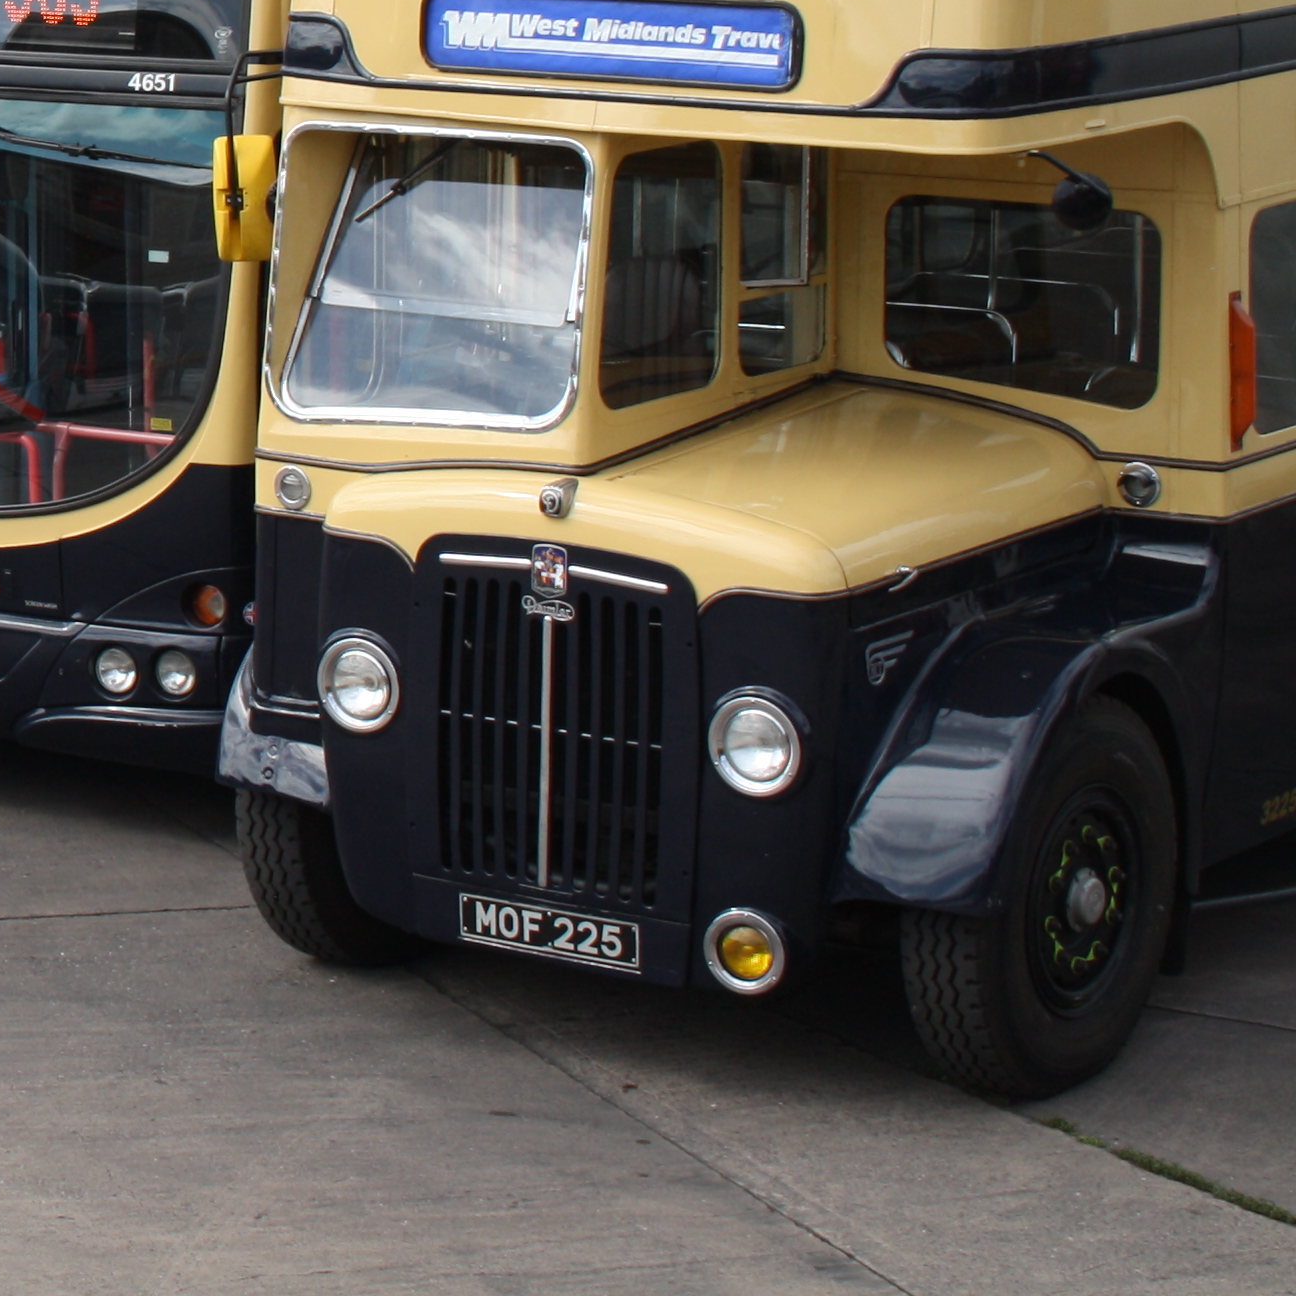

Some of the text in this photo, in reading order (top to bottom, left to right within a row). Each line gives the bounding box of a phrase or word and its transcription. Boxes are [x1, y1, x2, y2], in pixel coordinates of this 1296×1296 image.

[510, 14, 579, 38] West
[582, 18, 707, 45] Midlands
[127, 73, 176, 93] 4651
[474, 901, 623, 958] MOF 225
